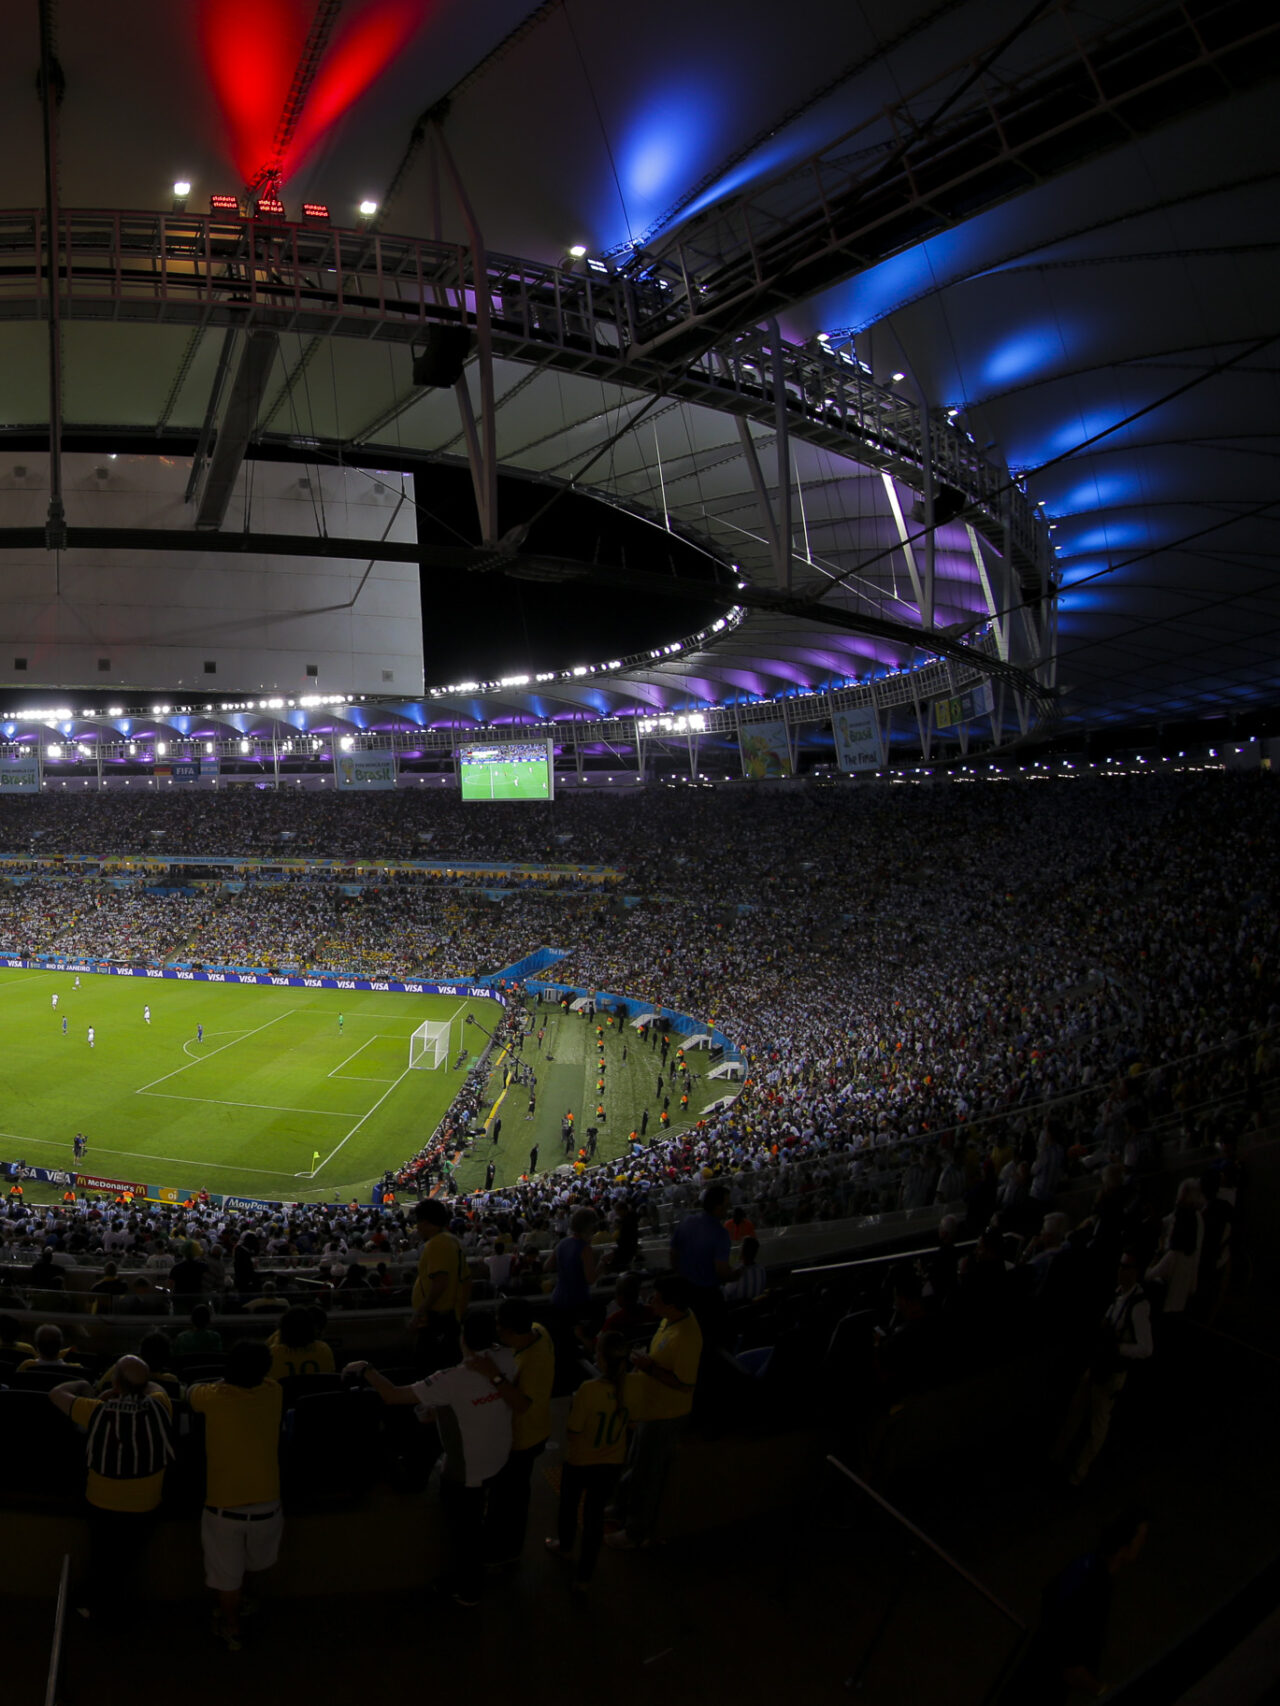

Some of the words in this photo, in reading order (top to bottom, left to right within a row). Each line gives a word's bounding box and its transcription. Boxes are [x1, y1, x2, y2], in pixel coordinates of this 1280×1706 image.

[844, 754, 856, 765] The
[858, 751, 876, 764] Final
[355, 768, 390, 780] Brasil
[2, 774, 34, 784] Brasil
[146, 969, 163, 977] VISA
[176, 971, 194, 980] VISA
[207, 973, 225, 982] VISA
[239, 975, 257, 984] VISA
[271, 977, 289, 986] VISA
[303, 979, 322, 987] VISA
[336, 980, 355, 989] VISA
[370, 982, 389, 991] VISA
[403, 984, 423, 992] VISA
[437, 986, 456, 994] VISA
[471, 988, 490, 997] VISA
[45, 1171, 71, 1184] VIA
[87, 1179, 134, 1192] McDonald's
[168, 1191, 177, 1200] oi
[228, 1198, 270, 1211] MoyPar
[595, 1408, 629, 1446] 10
